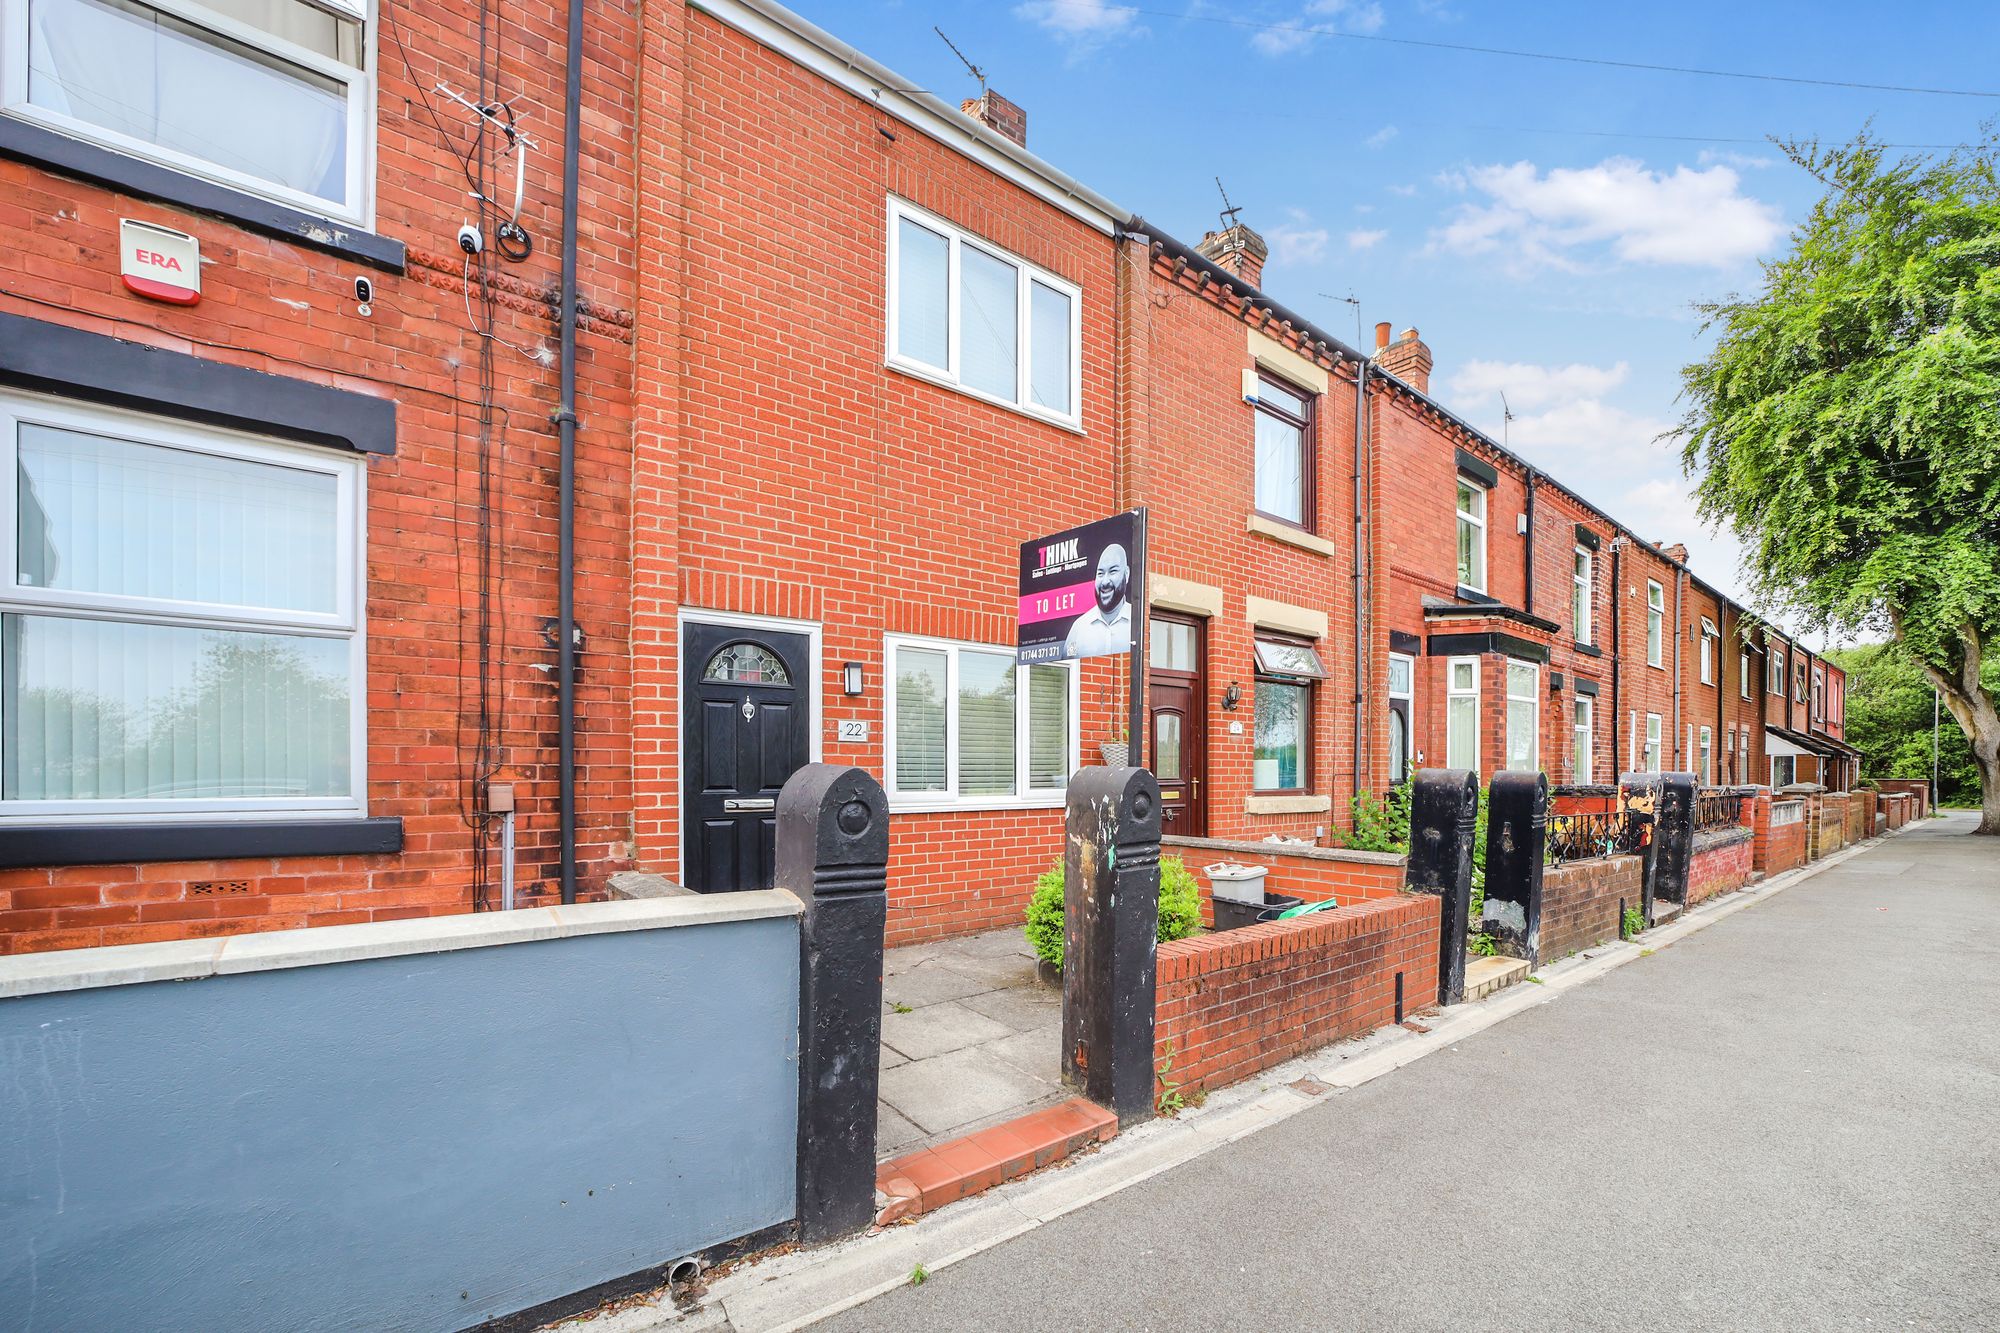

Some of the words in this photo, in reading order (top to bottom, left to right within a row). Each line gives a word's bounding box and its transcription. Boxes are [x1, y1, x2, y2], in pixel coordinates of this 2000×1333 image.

[136, 248, 183, 272] ERA
[1038, 537, 1079, 568] THINK
[1036, 598, 1049, 615] TO
[1056, 593, 1075, 611] LET
[1021, 649, 1037, 661] 01744
[1037, 647, 1048, 659] 371
[1048, 646, 1060, 657] 371
[846, 722, 862, 736] 22
